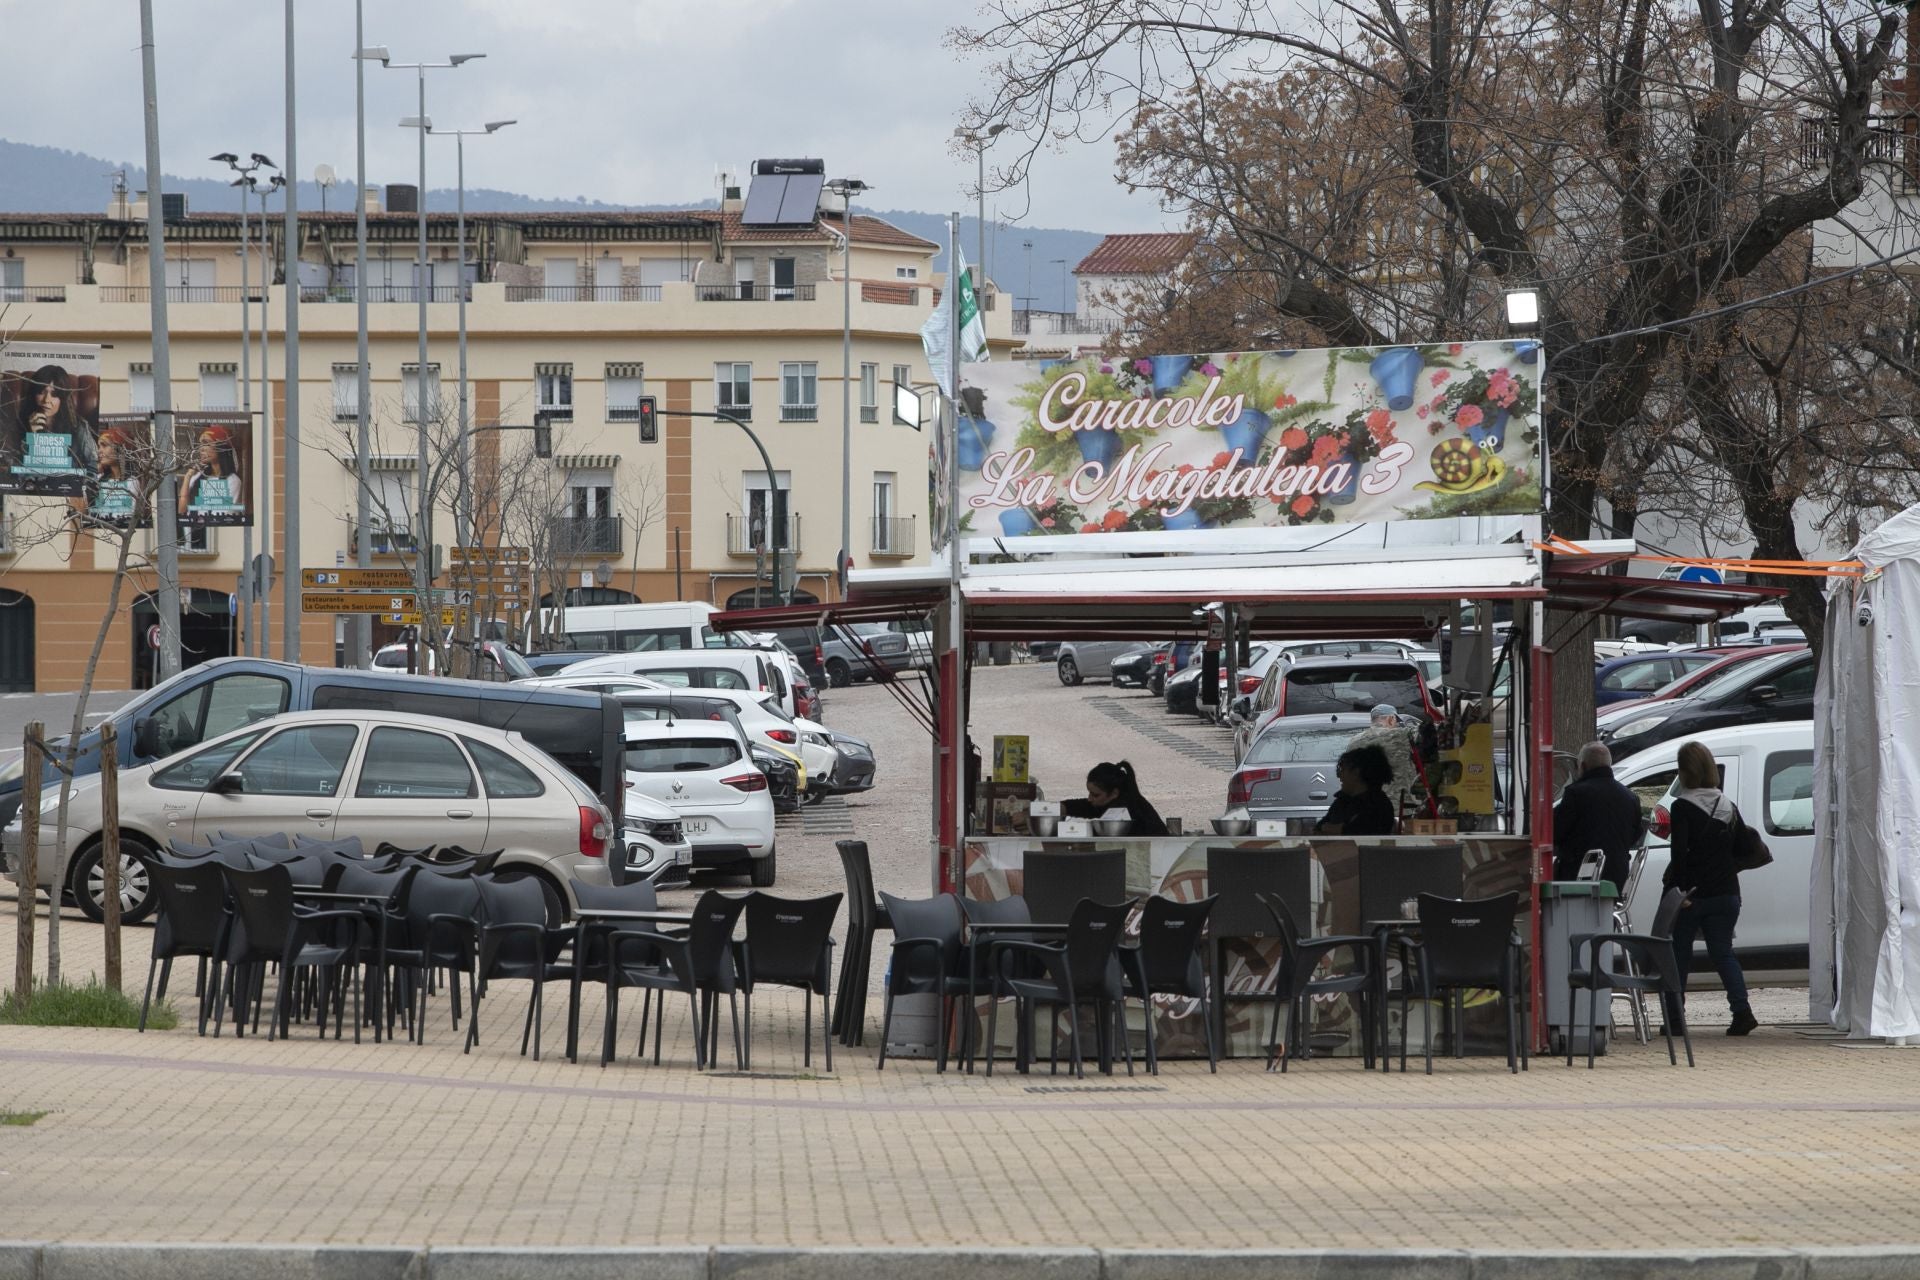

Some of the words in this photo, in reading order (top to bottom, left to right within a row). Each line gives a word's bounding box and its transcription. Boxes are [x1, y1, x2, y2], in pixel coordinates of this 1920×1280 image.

[1038, 371, 1245, 433] Caracoles
[969, 447, 1056, 509] La
[1070, 441, 1352, 518] Magdalena
[1362, 441, 1415, 495] 3
[686, 822, 708, 833] LHJ
